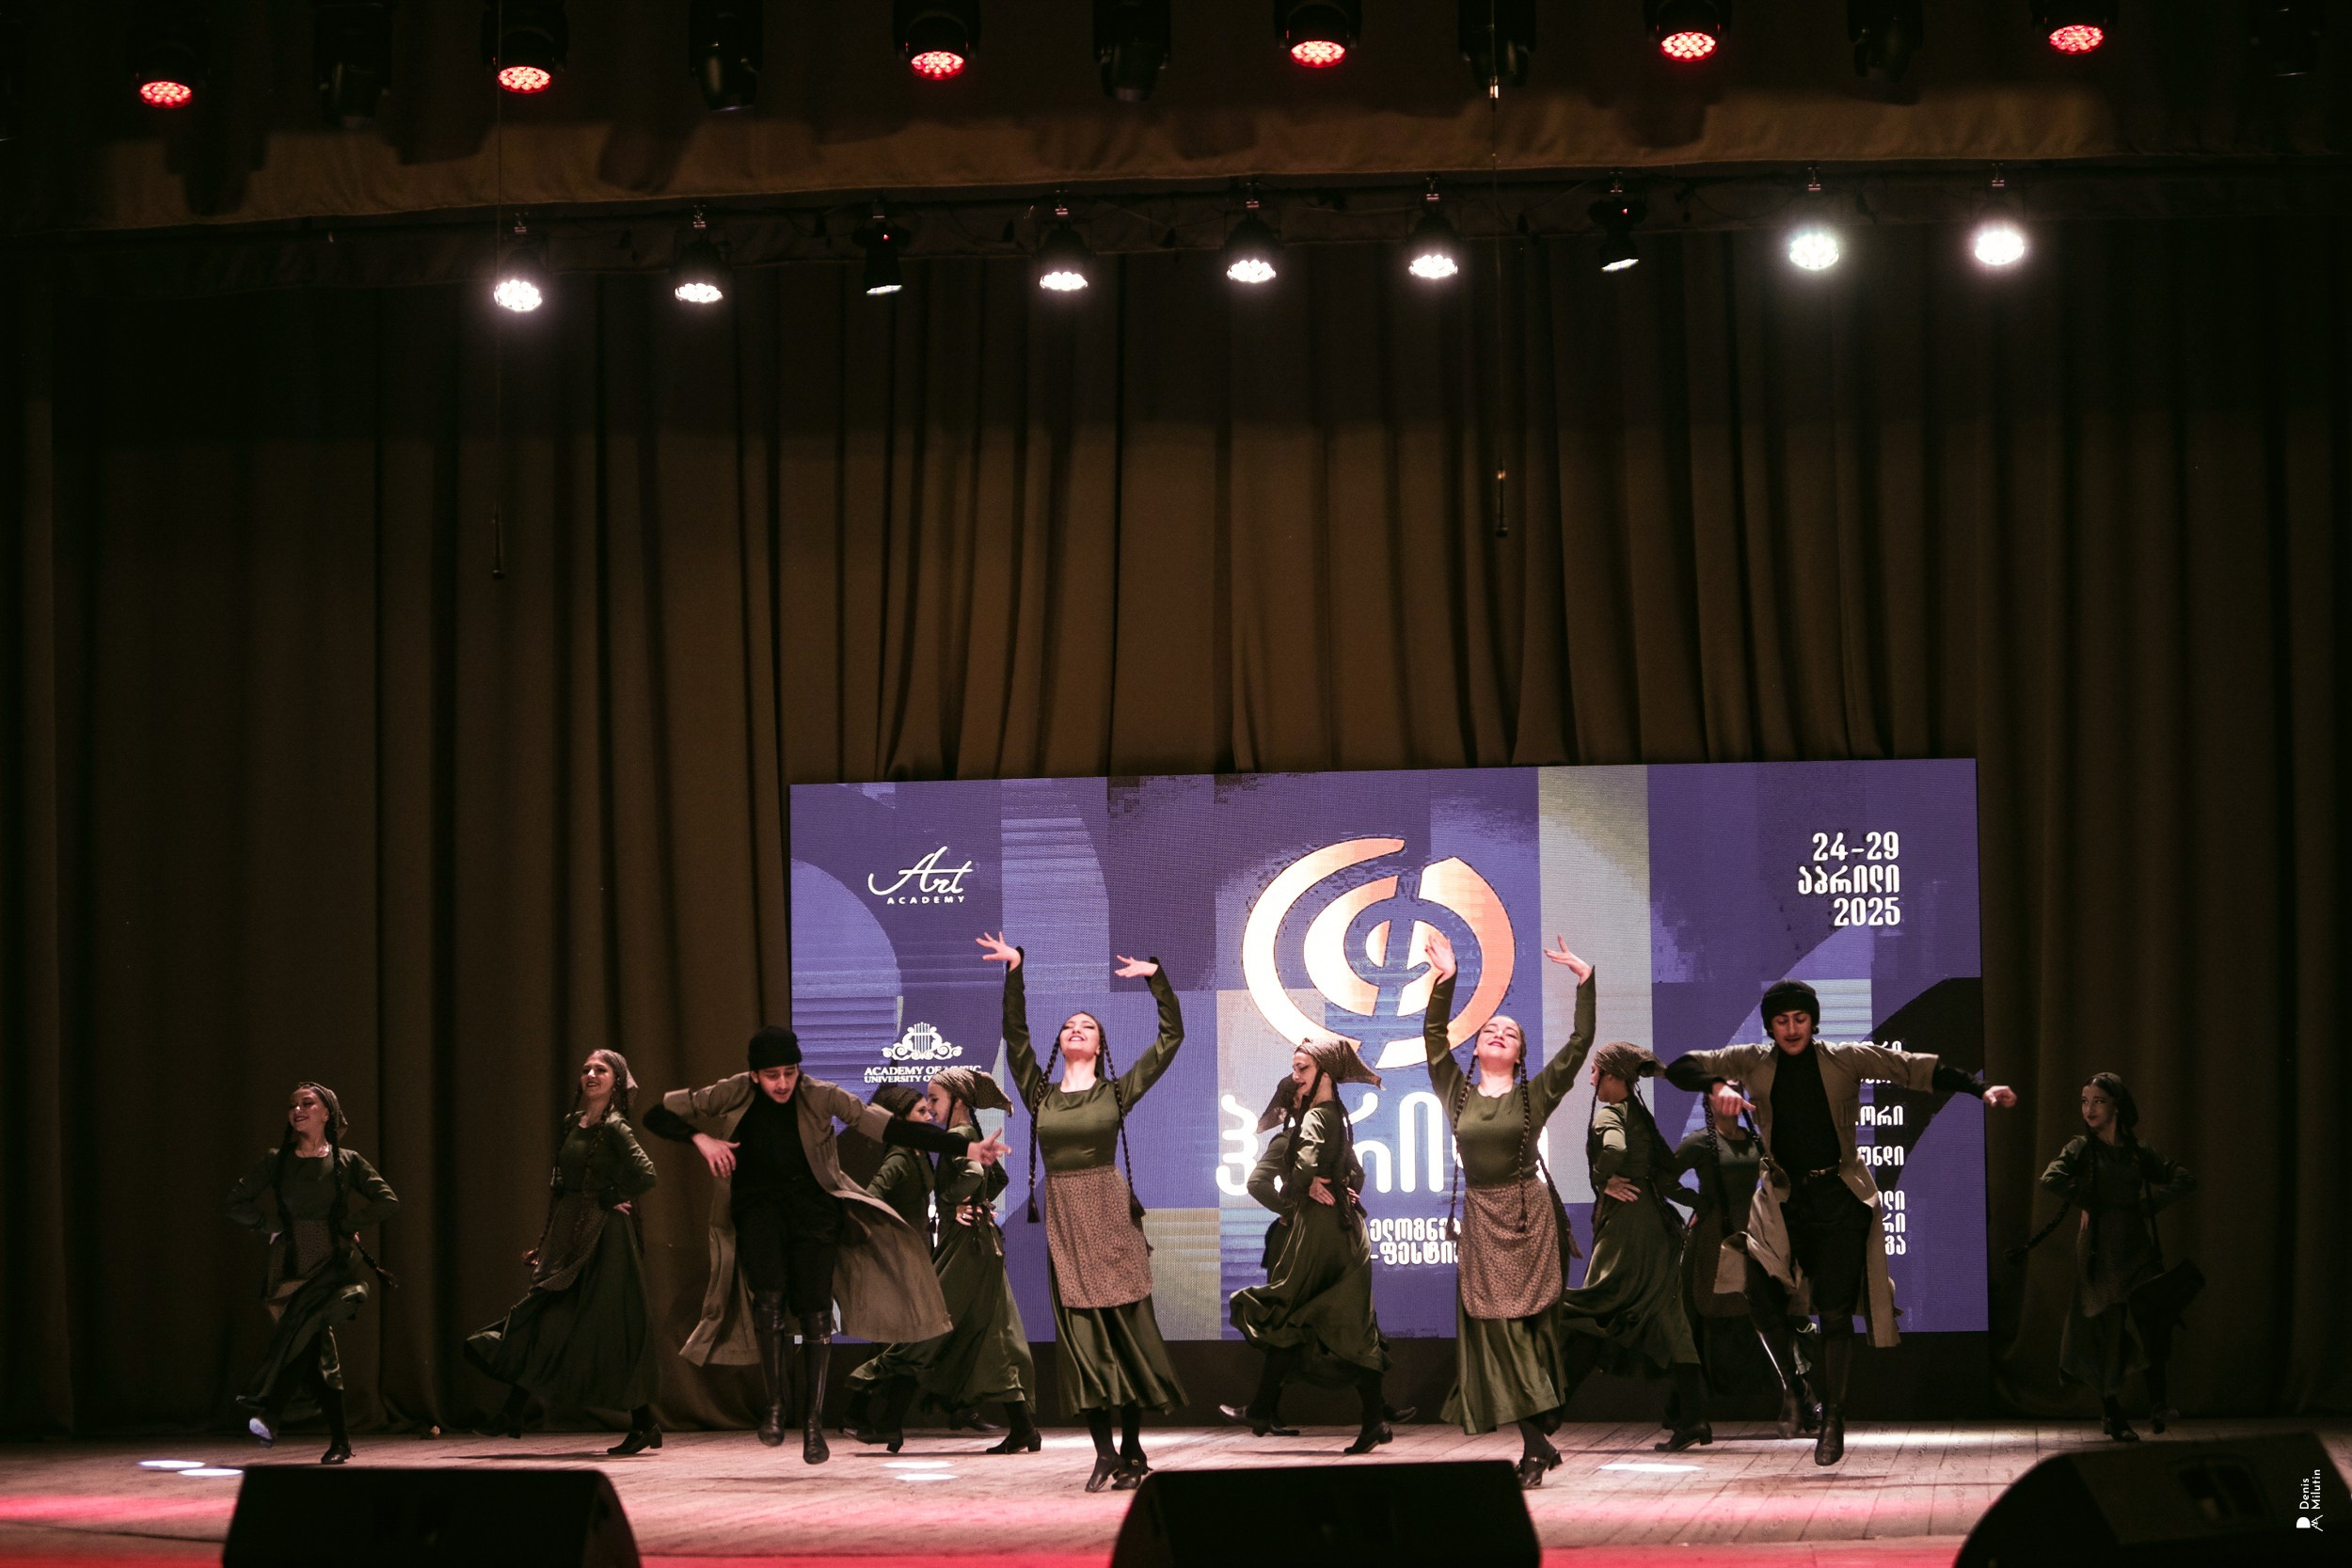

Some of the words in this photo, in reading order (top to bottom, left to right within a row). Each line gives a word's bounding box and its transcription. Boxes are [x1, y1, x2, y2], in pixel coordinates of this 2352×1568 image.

[1812, 831, 1899, 862] 24-29
[867, 846, 974, 895] Art
[1798, 864, 1900, 895] აპრილი
[886, 895, 964, 905] ACADEMY
[1833, 896, 1901, 927] 2025
[864, 1066, 925, 1076] ACADEMY
[864, 1075, 923, 1084] UNIVERSITY
[1855, 1105, 1904, 1126] ორი
[1370, 1241, 1458, 1265] -ფესტი
